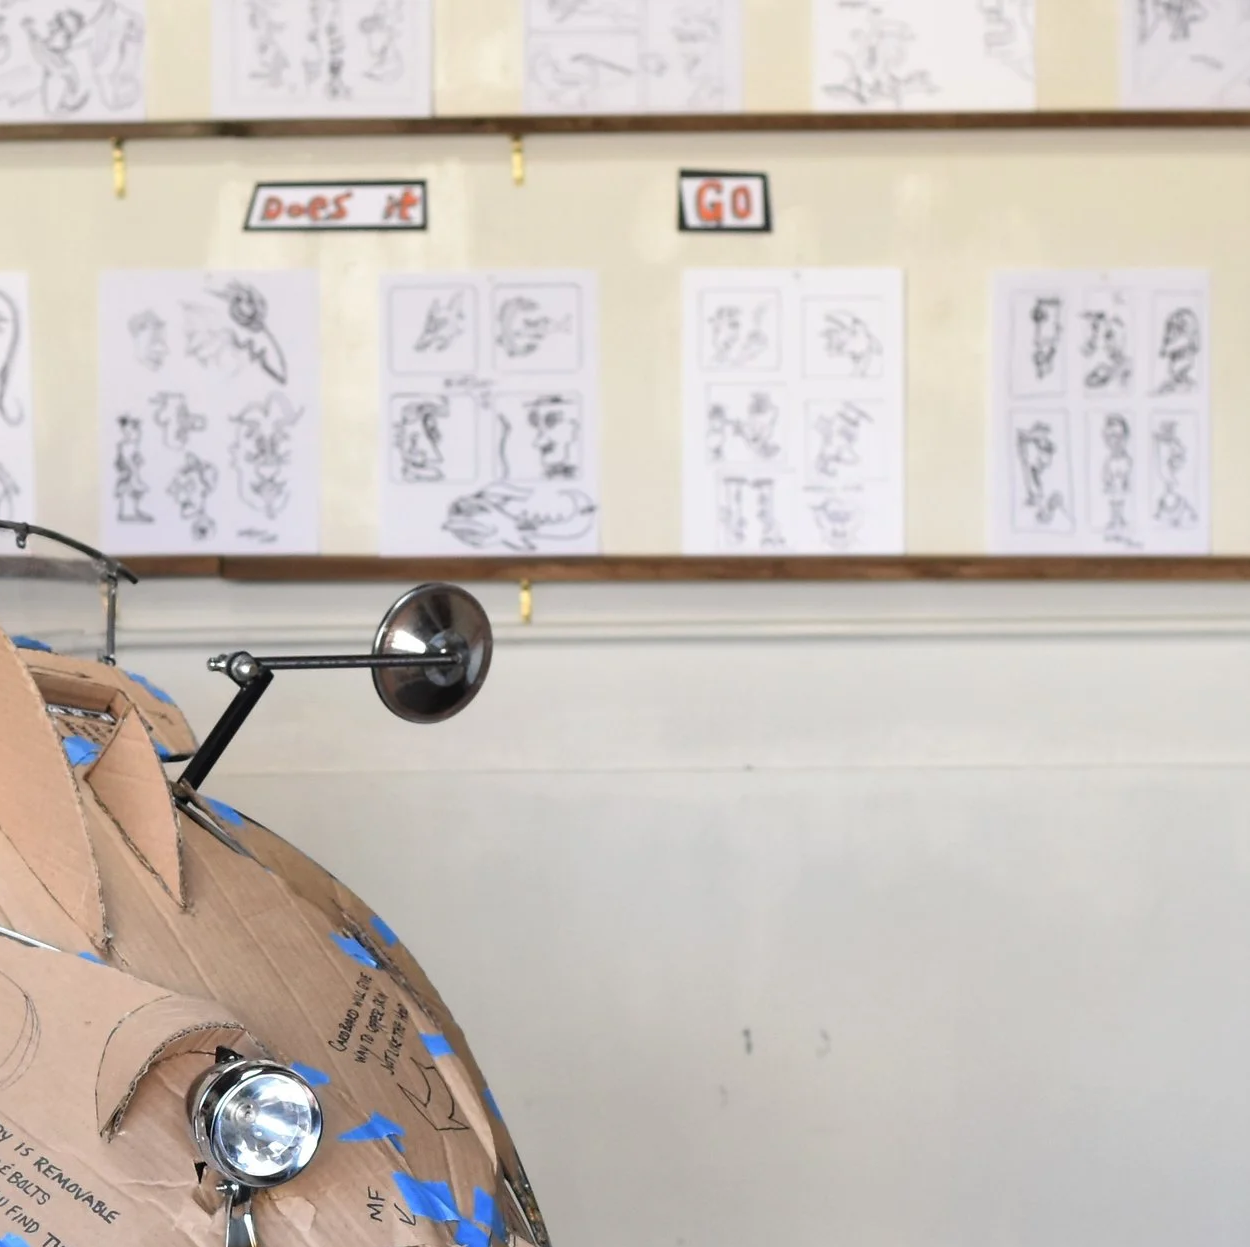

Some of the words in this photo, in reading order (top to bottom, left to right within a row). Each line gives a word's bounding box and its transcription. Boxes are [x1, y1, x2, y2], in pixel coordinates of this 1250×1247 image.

[7, 1171, 51, 1206] BOLTS
[14, 1142, 35, 1157] IS
[33, 1156, 121, 1225] REMOVABLE
[5, 1205, 40, 1234] FIND
[366, 1186, 385, 1222] MF
